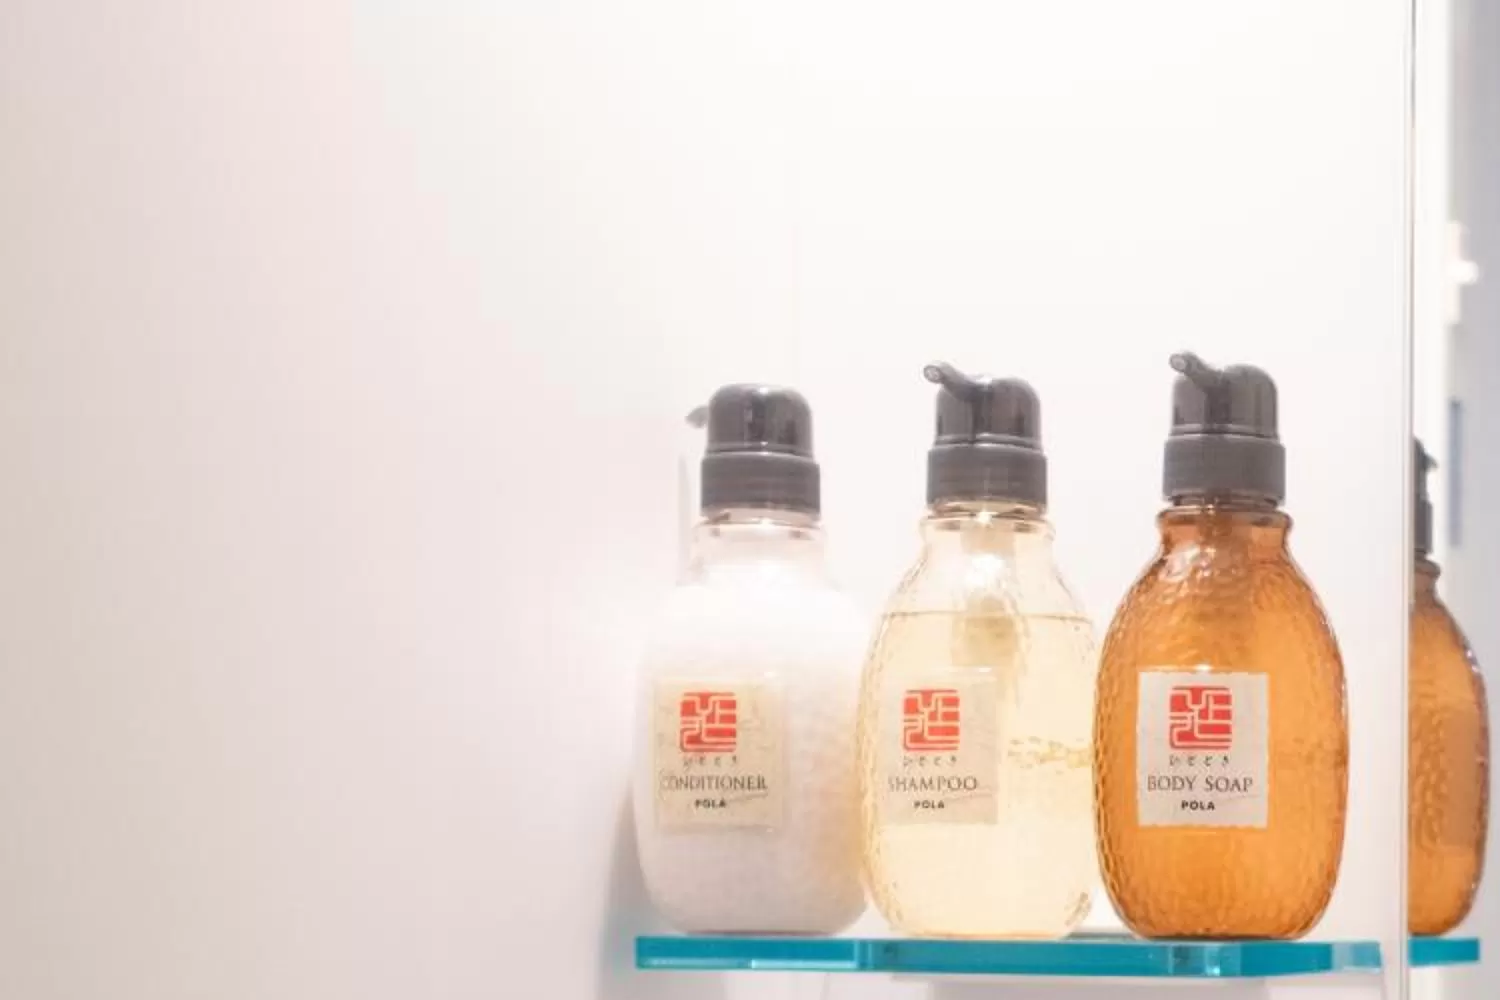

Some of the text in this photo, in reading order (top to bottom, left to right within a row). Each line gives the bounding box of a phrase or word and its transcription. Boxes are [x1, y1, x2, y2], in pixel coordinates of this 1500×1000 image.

[660, 773, 769, 791] CONDITIONER
[887, 775, 979, 793] SHAMPOO
[1146, 774, 1254, 794] BODY SOAP
[694, 798, 728, 809] POLA
[913, 799, 946, 810] POLA
[1180, 799, 1216, 811] POLA
